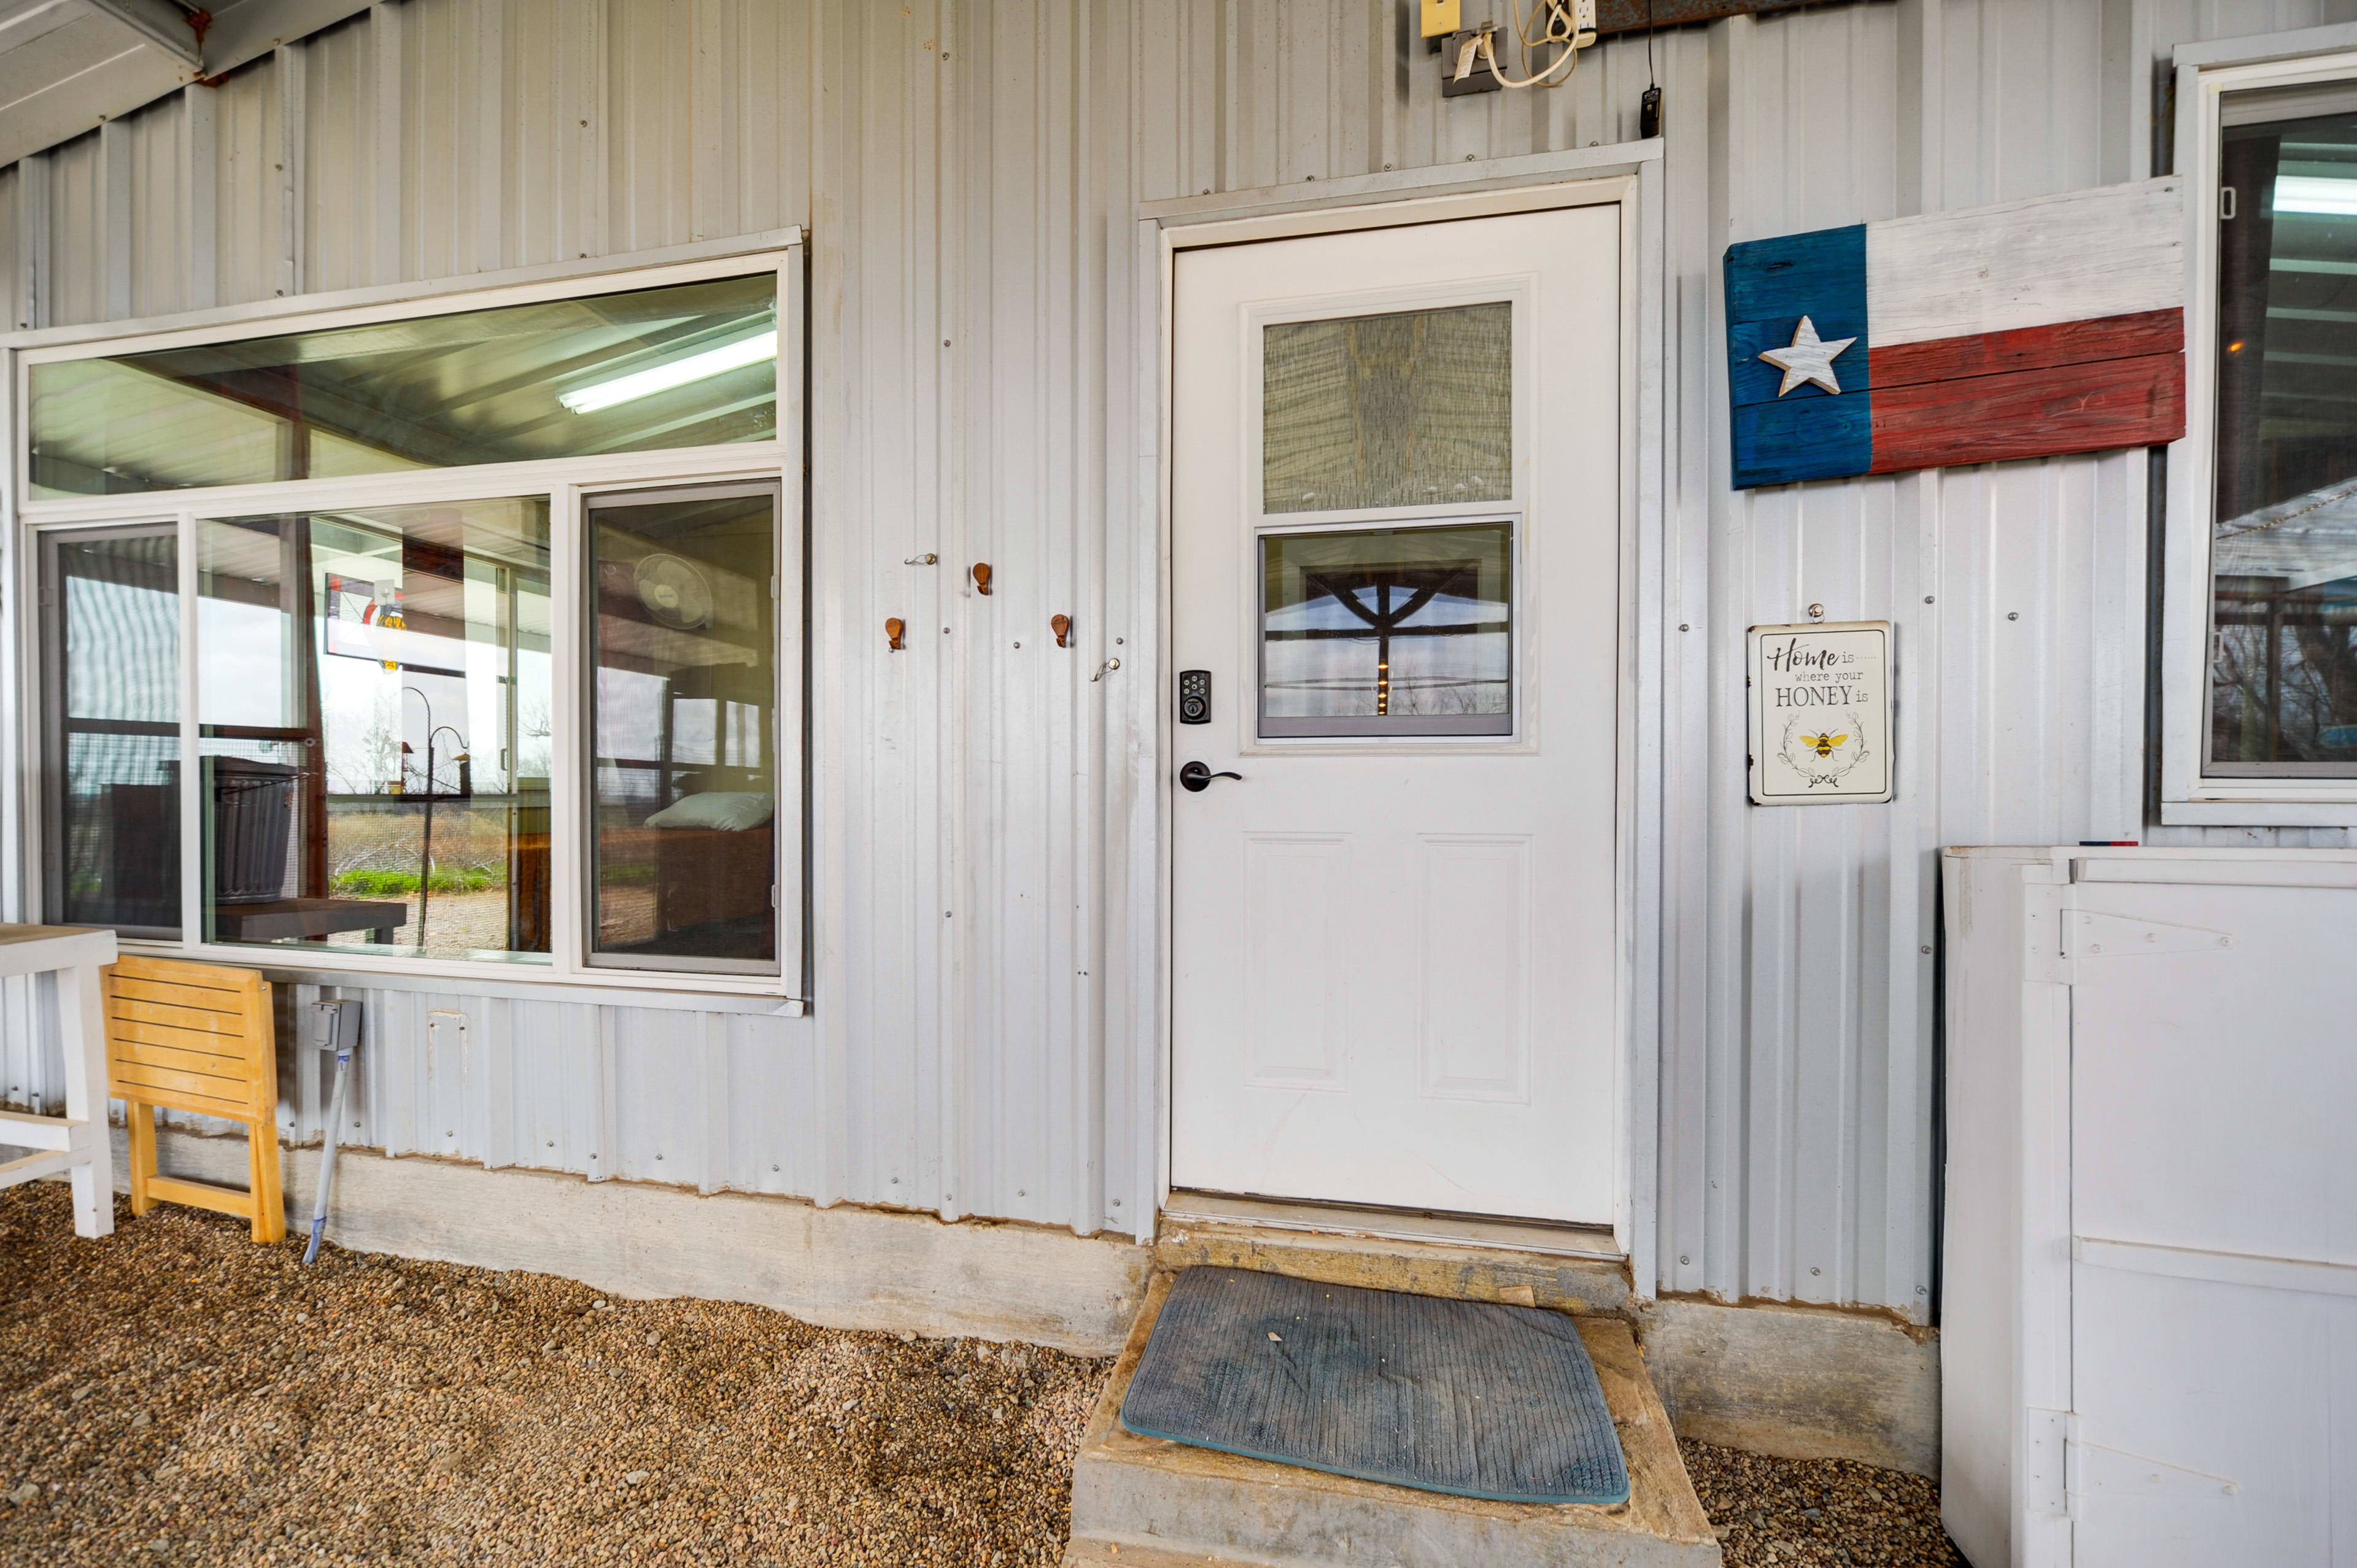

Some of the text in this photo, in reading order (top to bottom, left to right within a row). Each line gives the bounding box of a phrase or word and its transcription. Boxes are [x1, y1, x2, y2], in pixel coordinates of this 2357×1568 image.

[1767, 638, 1854, 672] Home is
[1795, 671, 1864, 683] where your
[1775, 686, 1868, 707] HONEY is
